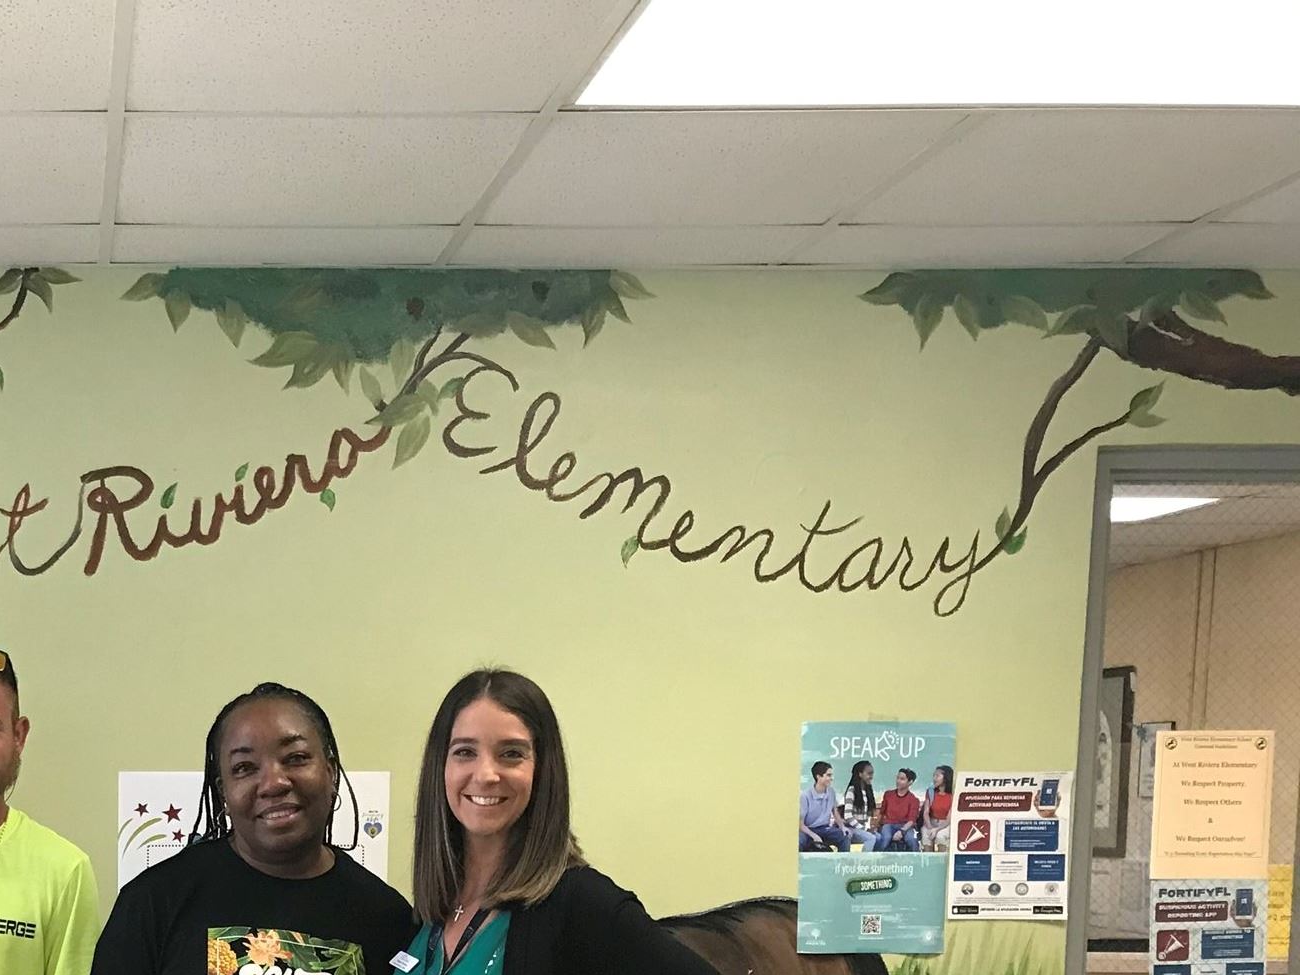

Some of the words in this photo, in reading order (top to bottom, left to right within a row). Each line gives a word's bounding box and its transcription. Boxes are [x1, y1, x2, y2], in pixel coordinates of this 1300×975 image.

[82, 422, 388, 576] Riviera
[442, 358, 1000, 615] Elementary
[830, 731, 897, 761] SPEAK
[900, 736, 925, 758] UP
[870, 863, 914, 877] something
